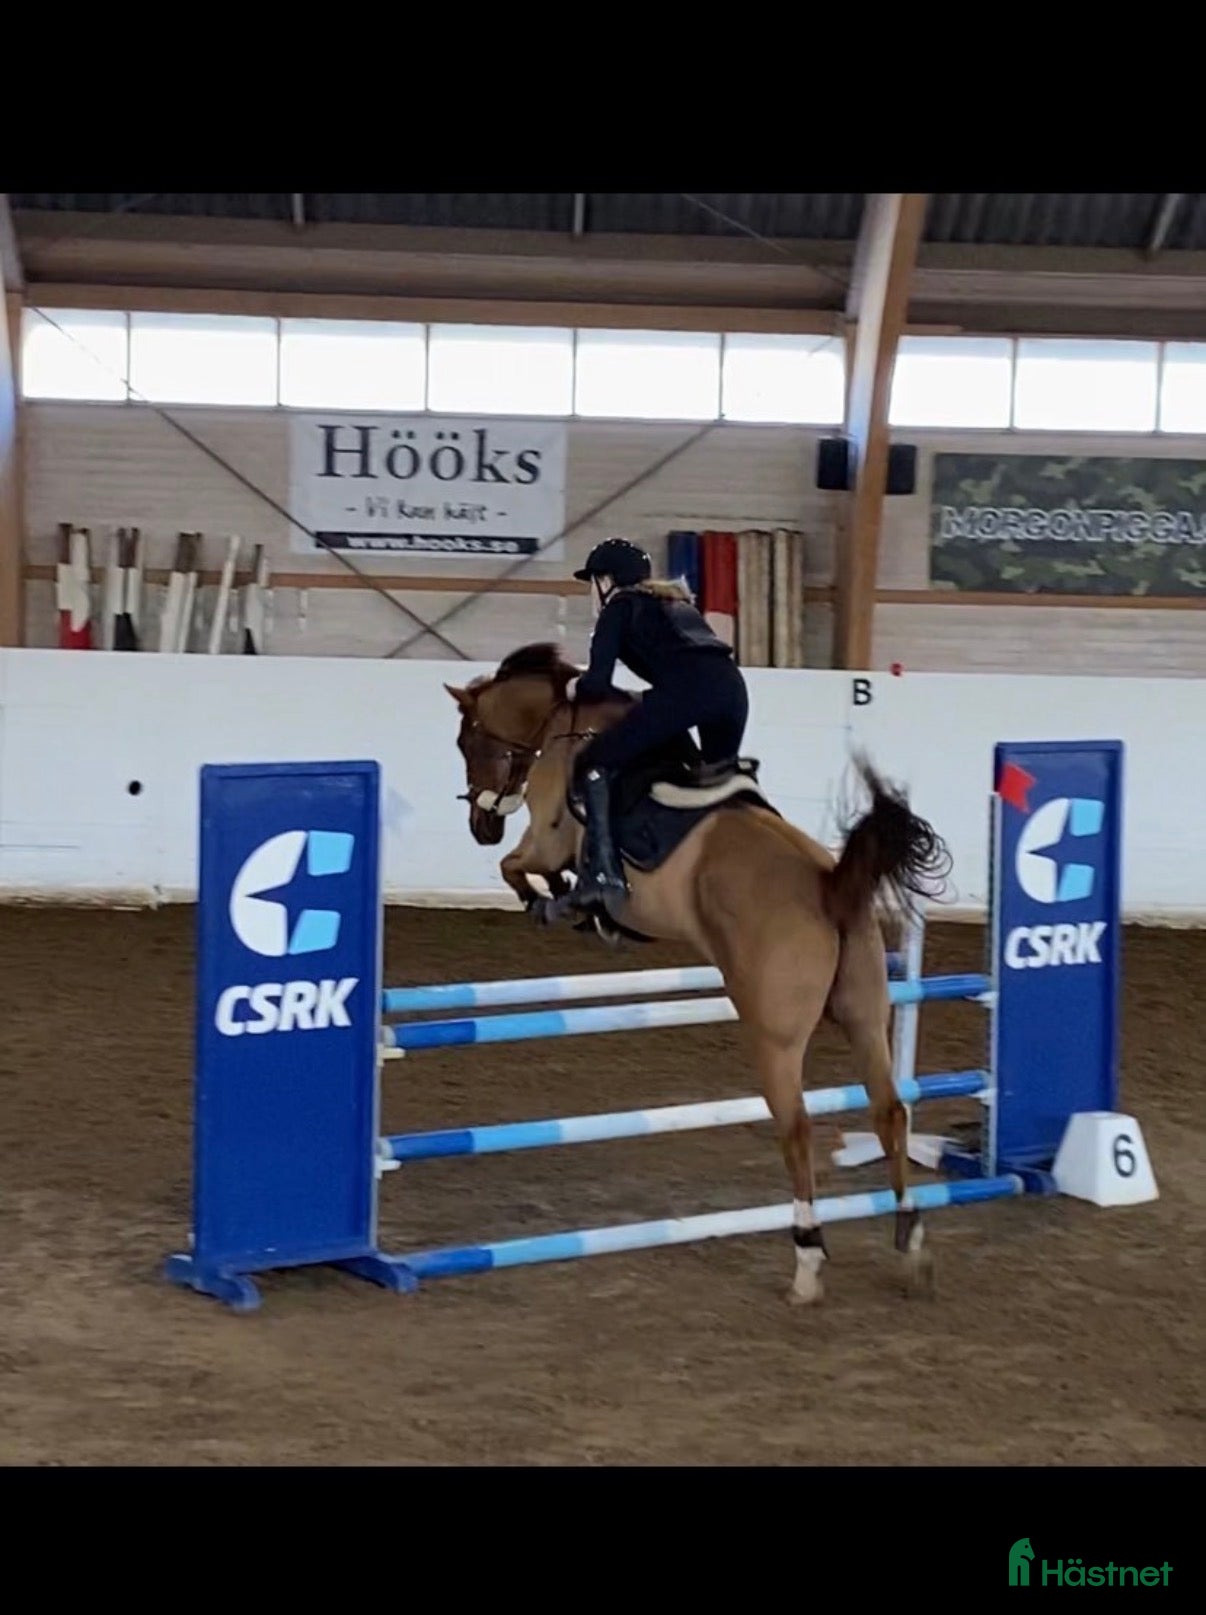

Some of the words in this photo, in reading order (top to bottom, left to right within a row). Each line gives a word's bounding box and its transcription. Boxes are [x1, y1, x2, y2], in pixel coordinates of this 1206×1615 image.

[316, 424, 542, 485] Hööks
[940, 506, 1206, 544] MORGONPIGGA
[853, 678, 871, 705] B
[1004, 921, 1107, 969] CSRK
[215, 977, 360, 1036] CSRK
[1112, 1133, 1136, 1178] 6
